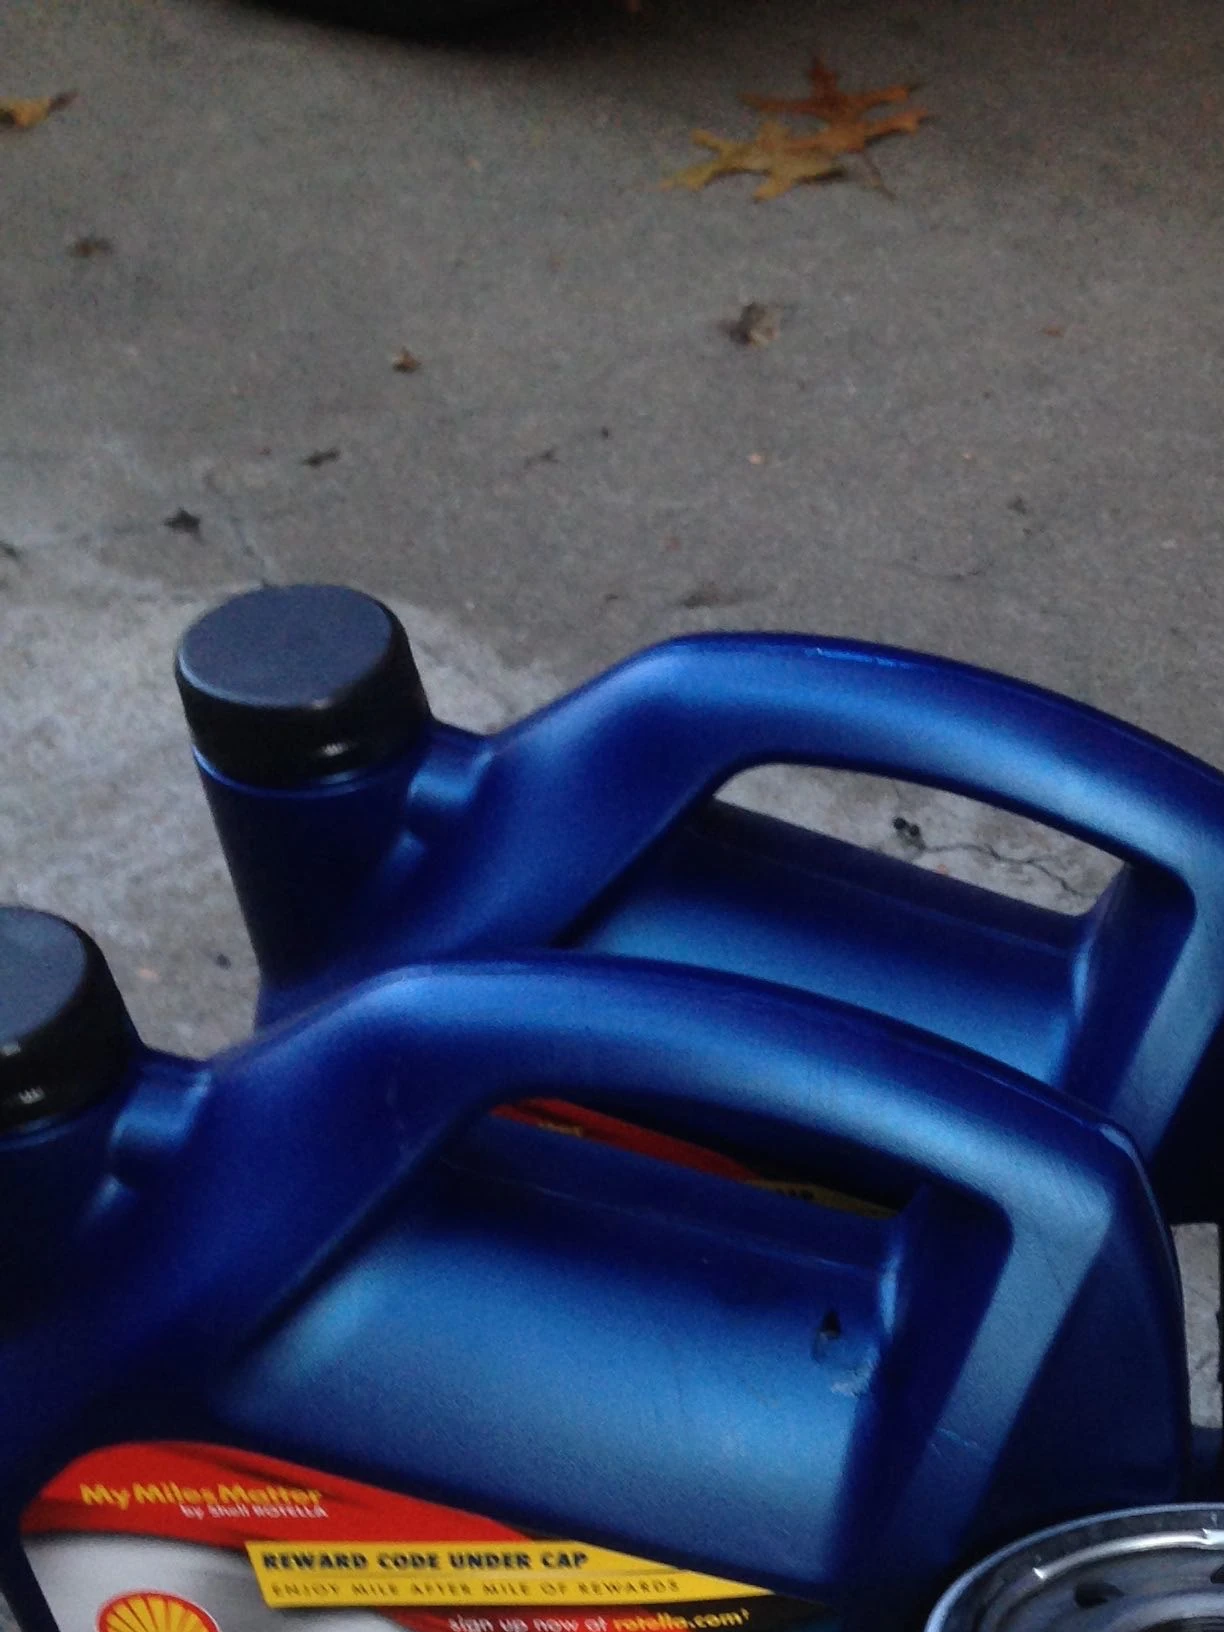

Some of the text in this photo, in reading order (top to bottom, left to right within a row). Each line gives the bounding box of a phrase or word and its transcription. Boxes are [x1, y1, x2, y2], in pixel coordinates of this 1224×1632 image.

[80, 1482, 323, 1511] My Miles Matter
[262, 1551, 589, 1571] REWARD CODE UNDER CAP
[271, 1578, 681, 1598] ENJOY MILE AFTER MILE OF REWARDS
